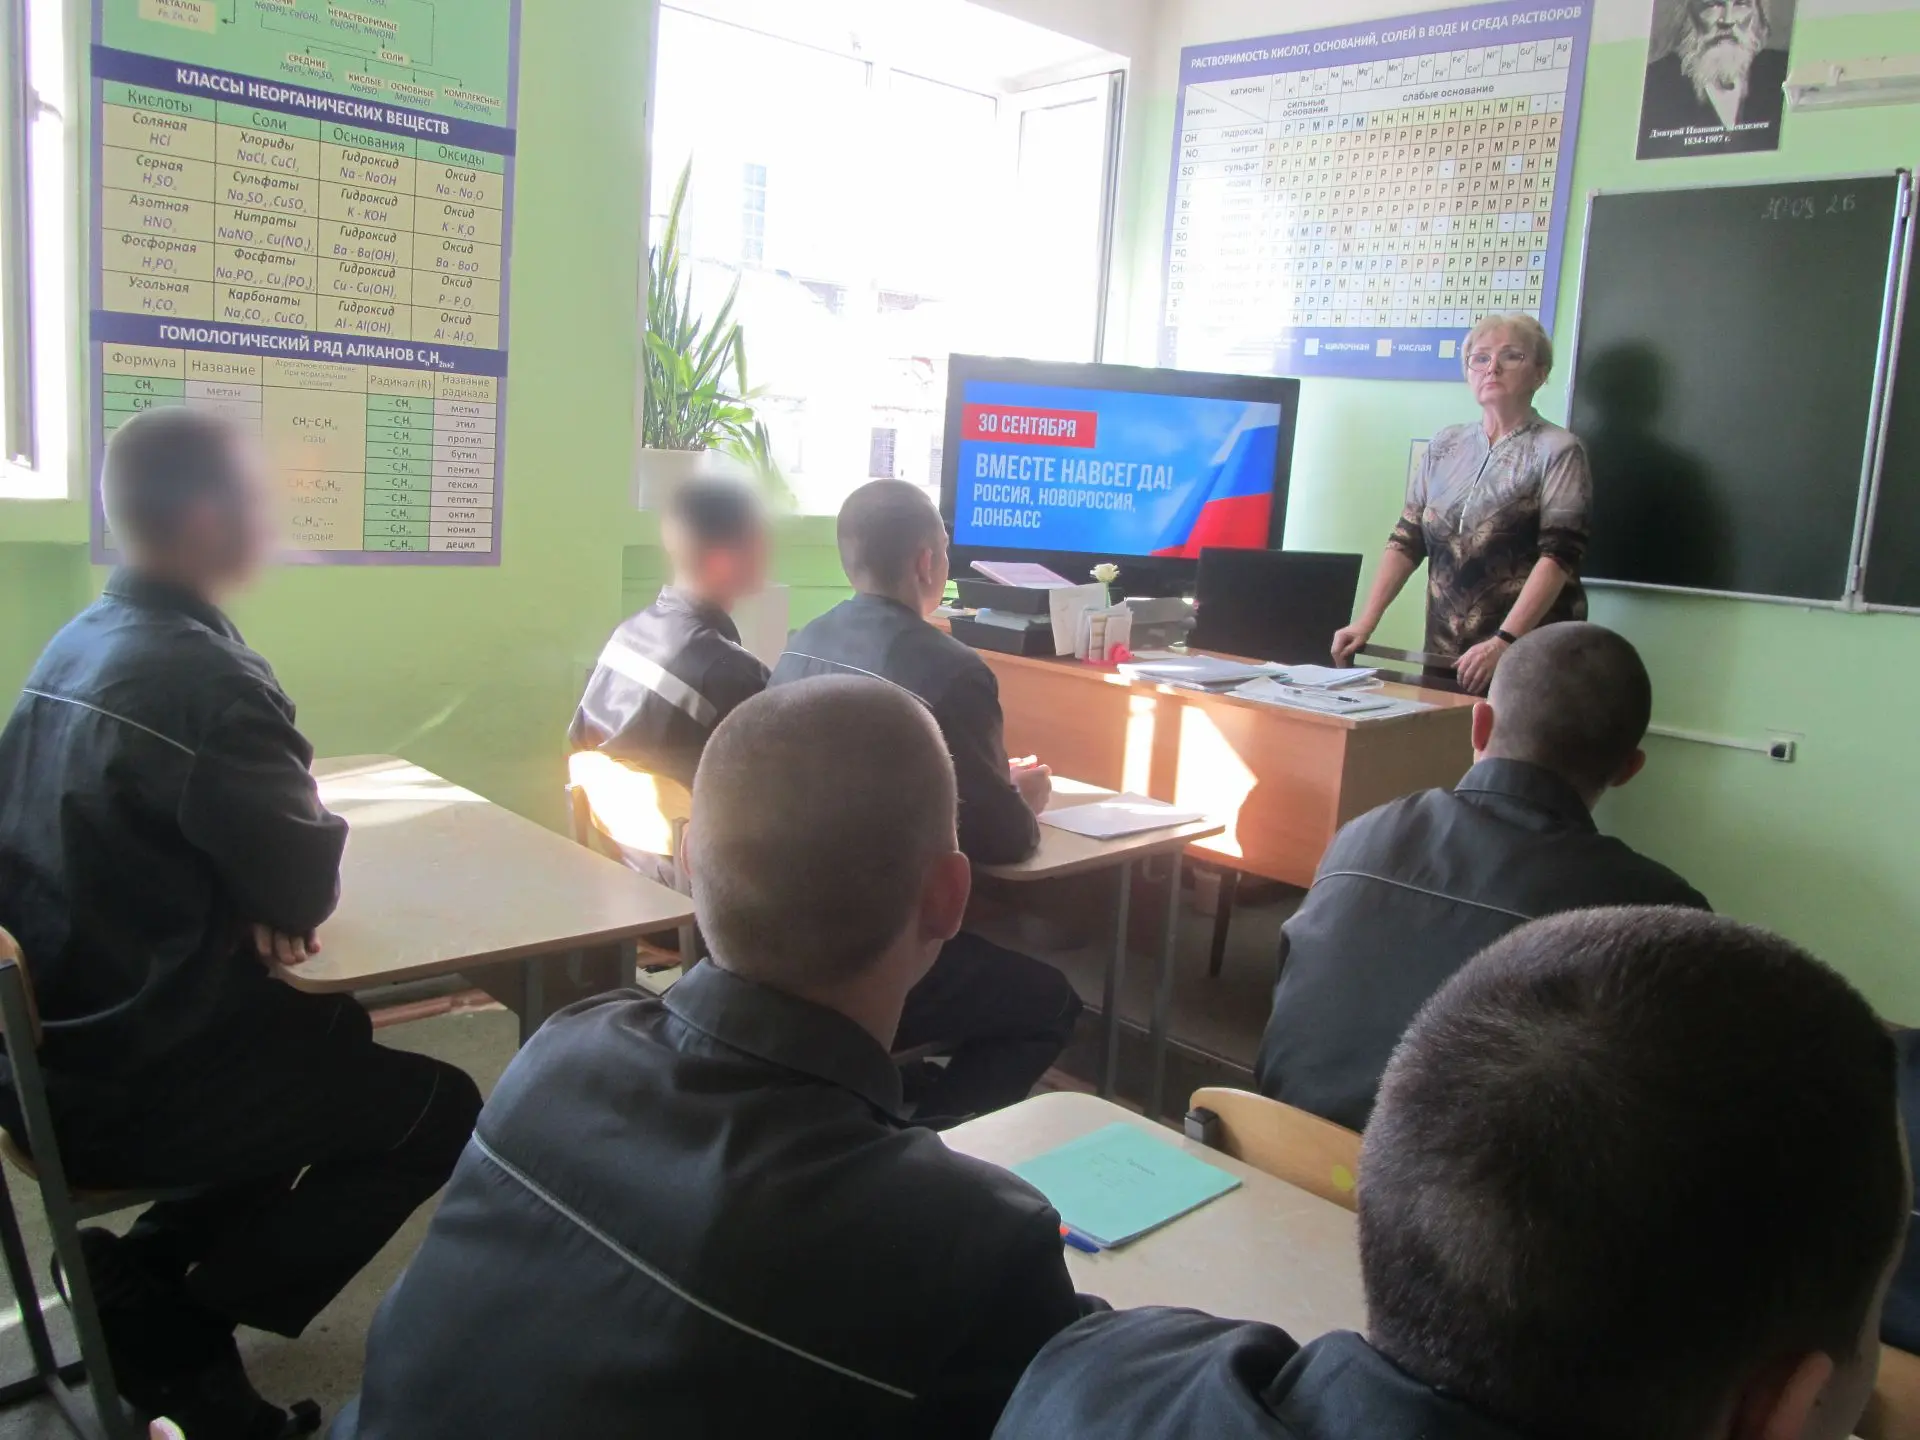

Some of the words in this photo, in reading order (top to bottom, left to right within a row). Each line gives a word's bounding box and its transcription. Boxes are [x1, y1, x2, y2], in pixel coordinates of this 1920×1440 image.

[328, 8, 398, 32] НЕРАСТВОРИМЫЕ
[1191, 51, 1269, 69] РАСТВОРИМОСТЬ
[1271, 44, 1311, 59] КИСЛОТ,
[1313, 32, 1378, 53] ОСНОВАНИЙ,
[1381, 26, 1416, 43] СОЛЕЙ
[1428, 22, 1457, 38] ВОДЕ
[1460, 20, 1469, 32] И
[1471, 16, 1509, 33] СРЕДА
[1511, 6, 1582, 26] РАСТВОРОВ
[288, 54, 327, 69] СРЕДНИЕ
[381, 51, 404, 62] СОЛИ
[348, 73, 382, 87] КИСЛЫЕ
[391, 82, 435, 99] ОСНОВНЫЕ
[444, 88, 500, 107] КОМПЛЕКСНЫЕ
[1230, 85, 1265, 96] катионы
[1402, 90, 1439, 102] слабые
[1441, 84, 1495, 98] основание
[176, 68, 243, 95] КЛАССЫ
[249, 82, 382, 122] НЕОРГАНИЧЕСКИХ
[386, 109, 450, 134] ВЕЩЕСТВ
[1287, 99, 1326, 109] сильные
[1282, 106, 1329, 118] основания
[128, 88, 193, 113] Кислоты
[252, 112, 288, 131] Соли
[333, 127, 405, 153] Основания
[438, 145, 485, 166] Оксиды
[132, 112, 188, 131] Соляная
[1649, 126, 1685, 138] Дмитрий
[1686, 124, 1724, 135] Иванович
[149, 132, 171, 147] HCl
[240, 131, 295, 151] Хлориды
[1683, 136, 1724, 146] 1834-1907
[1231, 144, 1258, 154] нитрат
[136, 154, 184, 173] Серная
[341, 149, 400, 170] Гидроксид
[1224, 162, 1260, 173] сульфат
[233, 170, 300, 193] Сульфаты
[339, 166, 356, 180] Na
[365, 170, 397, 186] NaOH
[445, 168, 477, 184] Оксид
[436, 183, 450, 196] Na
[129, 194, 189, 213] Азотная
[341, 187, 398, 208] Гидроксид
[234, 209, 297, 228] Нитраты
[347, 207, 355, 218] K
[364, 208, 388, 222] KOH
[443, 204, 475, 219] Оксид
[442, 221, 449, 232] K
[340, 225, 397, 244] Гидроксид
[122, 233, 197, 254] Фосфорная
[333, 243, 347, 256] Ba
[442, 240, 474, 254] Оксид
[234, 248, 296, 266] Фосфаты
[436, 257, 449, 268] Ba
[458, 260, 479, 272] BaO
[339, 262, 396, 279] Гидроксид
[129, 275, 190, 294] Угольная
[333, 279, 347, 291] Cu
[441, 275, 473, 289] Оксид
[228, 288, 301, 307] Карбонаты
[338, 300, 395, 317] Гидроксид
[440, 313, 472, 326] Оксид
[159, 324, 310, 352] ГОМОЛОГИЧЕСКИЙ
[314, 341, 343, 358] РЯД
[346, 343, 413, 362] АЛКАНОВ
[1398, 343, 1432, 352] кислая
[112, 351, 176, 369] Формула
[192, 359, 256, 376] Название
[371, 375, 415, 389] Радикал
[417, 378, 432, 391] (R)
[442, 375, 490, 388] Название
[206, 386, 241, 397] метан
[442, 388, 489, 400] радикала
[451, 406, 480, 415] метил
[455, 421, 476, 430] этил
[978, 413, 998, 433] 30
[1001, 415, 1078, 438] СЕНТЯБРЯ
[447, 436, 482, 446] пропил
[451, 450, 477, 460] бутил
[447, 466, 480, 475] пентил
[975, 452, 1056, 482] ВМЕСТЕ
[1060, 458, 1174, 492] НАВСЕГДА!
[447, 481, 478, 489] гексил
[447, 496, 478, 505] гептил
[973, 483, 1034, 506] РОССИЯ,
[1039, 488, 1137, 513] НОВОРОССИЯ,
[449, 510, 475, 519] октил
[971, 507, 1042, 529] ДОНБАСС
[447, 525, 476, 534] нонил
[446, 540, 475, 550] децил
